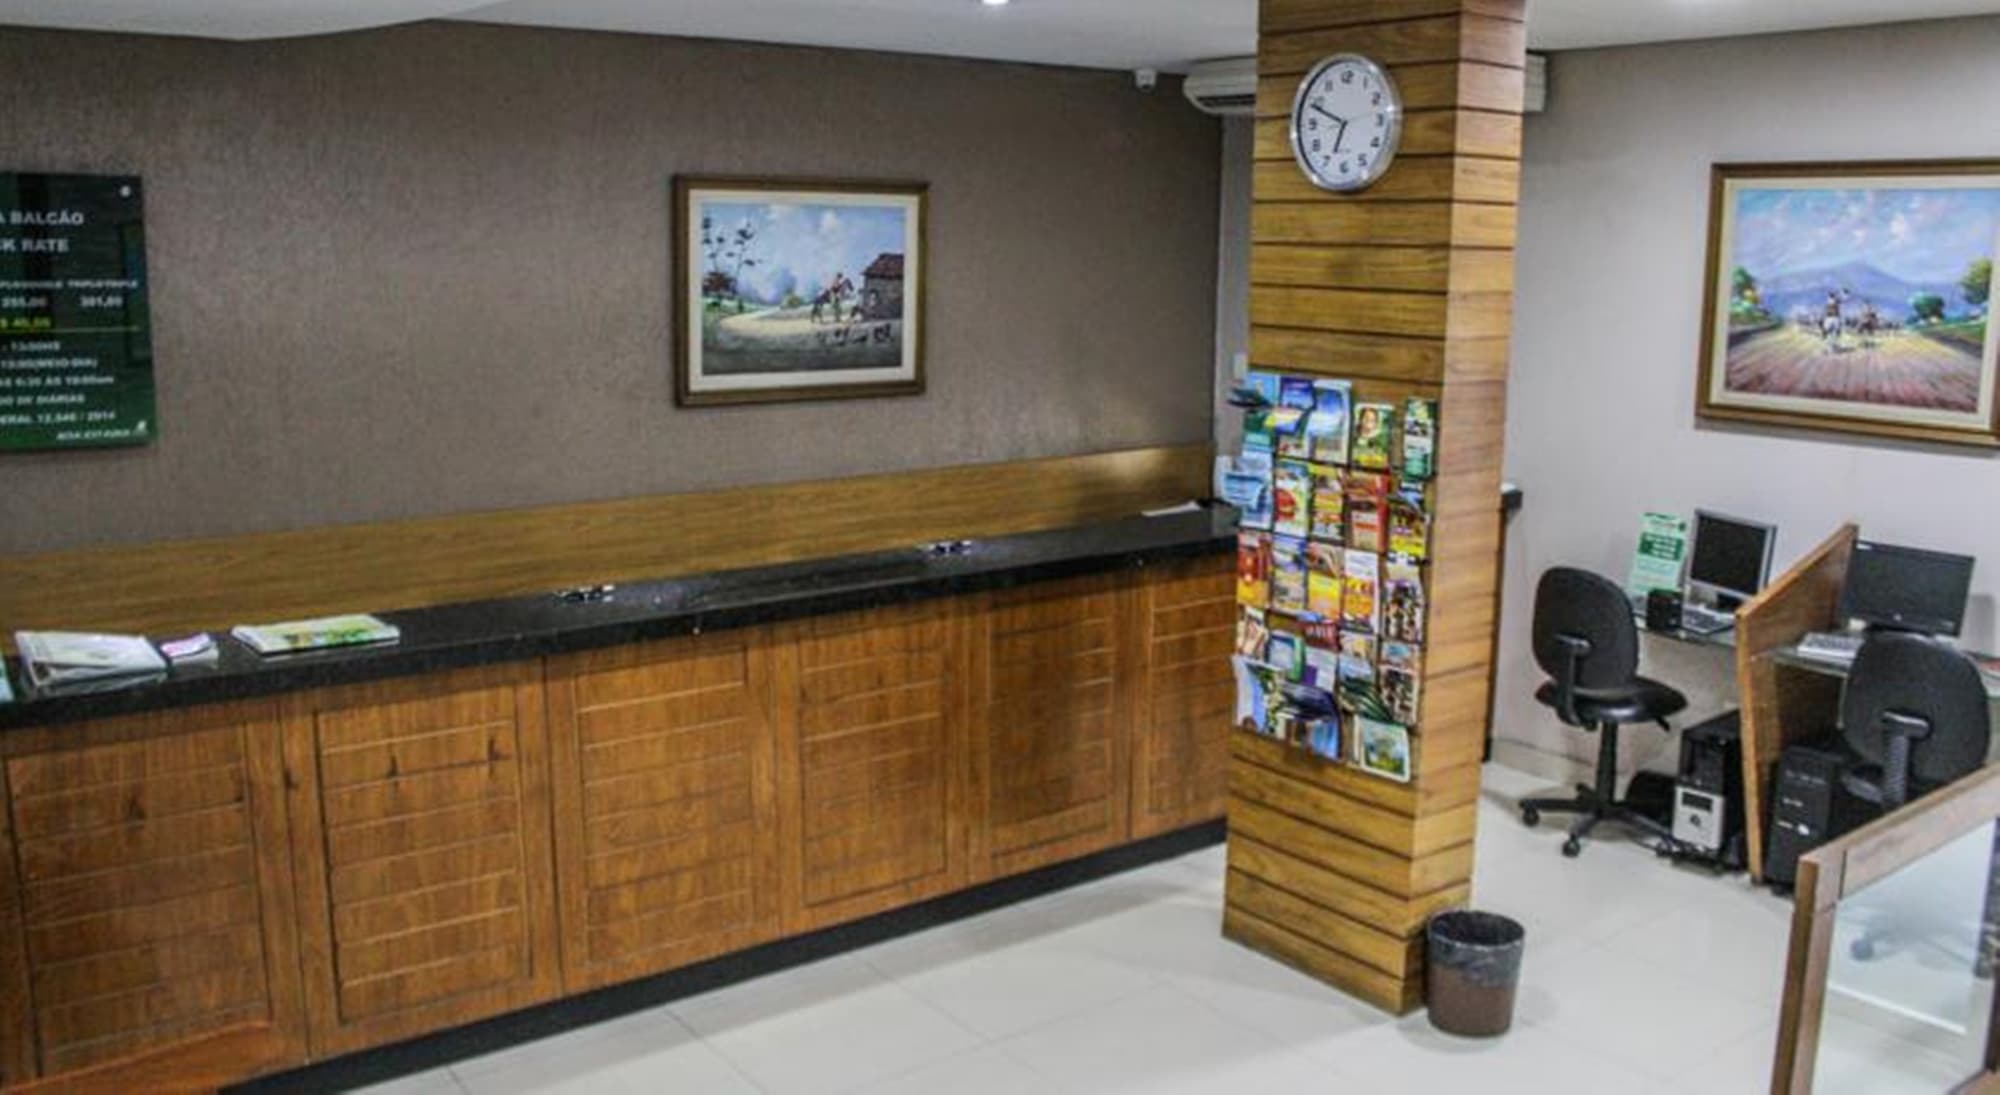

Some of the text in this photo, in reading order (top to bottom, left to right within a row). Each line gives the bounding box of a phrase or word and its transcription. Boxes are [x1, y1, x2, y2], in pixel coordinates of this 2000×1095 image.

[1340, 69, 1354, 84] 12
[1372, 91, 1381, 105] 2
[1308, 117, 1318, 130] 9
[1377, 113, 1384, 127] 3
[1312, 138, 1321, 152] 8
[1370, 136, 1379, 148] 4
[1324, 155, 1331, 167] 7
[1358, 153, 1367, 167] 5
[1340, 161, 1349, 174] 6
[10, 209, 84, 225] BALCÃO
[21, 239, 69, 253] RATE
